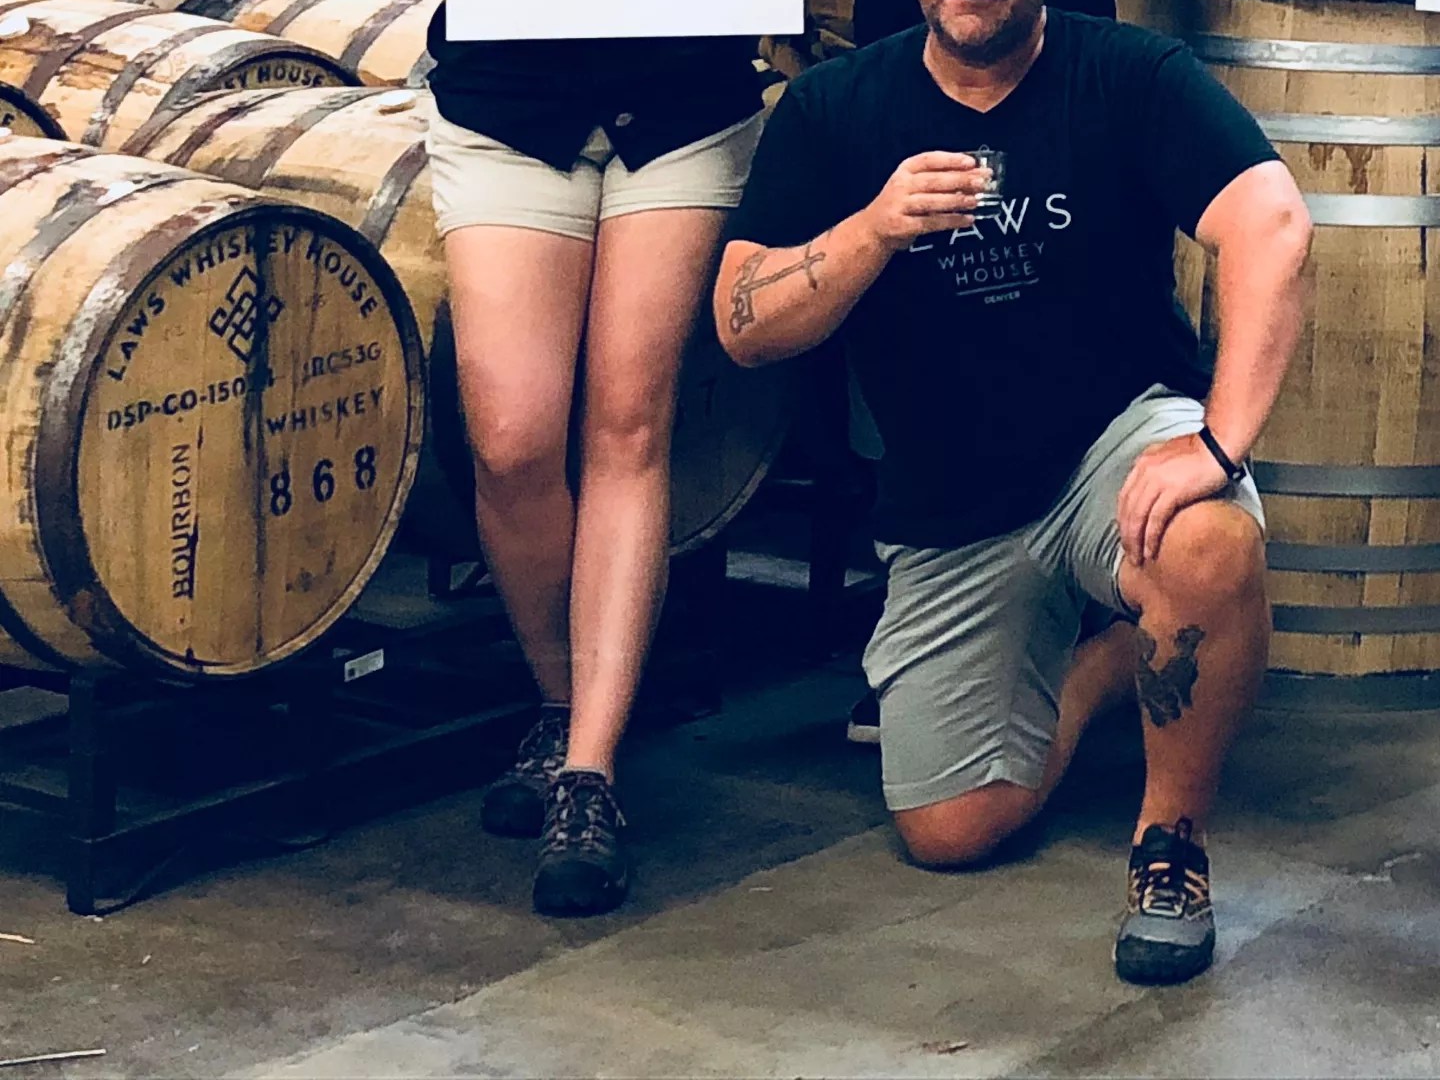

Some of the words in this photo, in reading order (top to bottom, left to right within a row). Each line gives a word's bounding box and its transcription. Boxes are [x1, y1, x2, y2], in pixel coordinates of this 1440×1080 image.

[937, 241, 1045, 270] WHISKEY
[955, 261, 1035, 286] HOUSE
[106, 291, 165, 382] LAWS
[305, 229, 378, 318] HOUSE
[267, 386, 384, 435] WHISKEY
[172, 442, 194, 600] BOURBON
